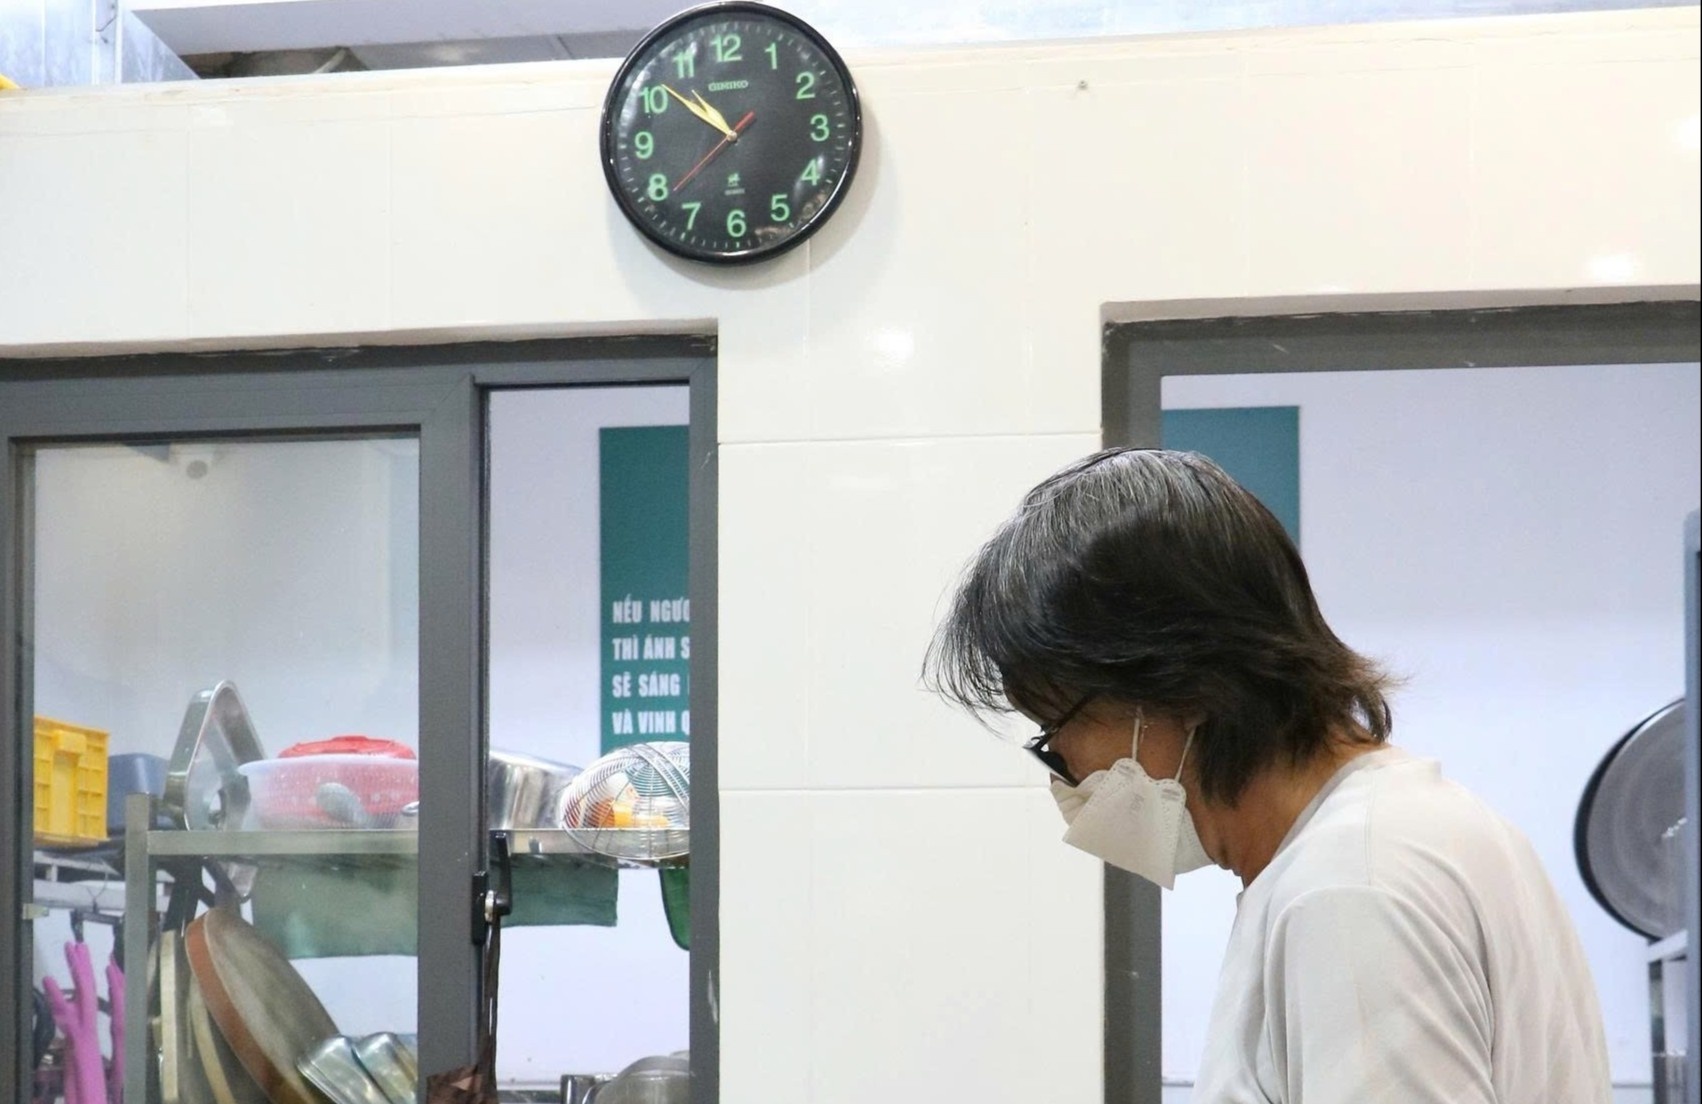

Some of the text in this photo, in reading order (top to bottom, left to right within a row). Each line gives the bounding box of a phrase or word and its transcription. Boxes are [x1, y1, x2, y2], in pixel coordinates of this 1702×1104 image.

[711, 34, 742, 63] 12
[764, 43, 778, 70] 1
[673, 51, 695, 79] 11
[640, 86, 668, 114] 10
[796, 72, 816, 100] 2
[810, 114, 830, 142] 3
[634, 131, 654, 159] 9
[801, 159, 821, 186] 4
[649, 174, 669, 201] 8
[682, 202, 702, 230] 7
[770, 194, 790, 222] 5
[727, 210, 747, 237] 6
[638, 671, 681, 698] SÁNG
[637, 710, 676, 734] VINH
